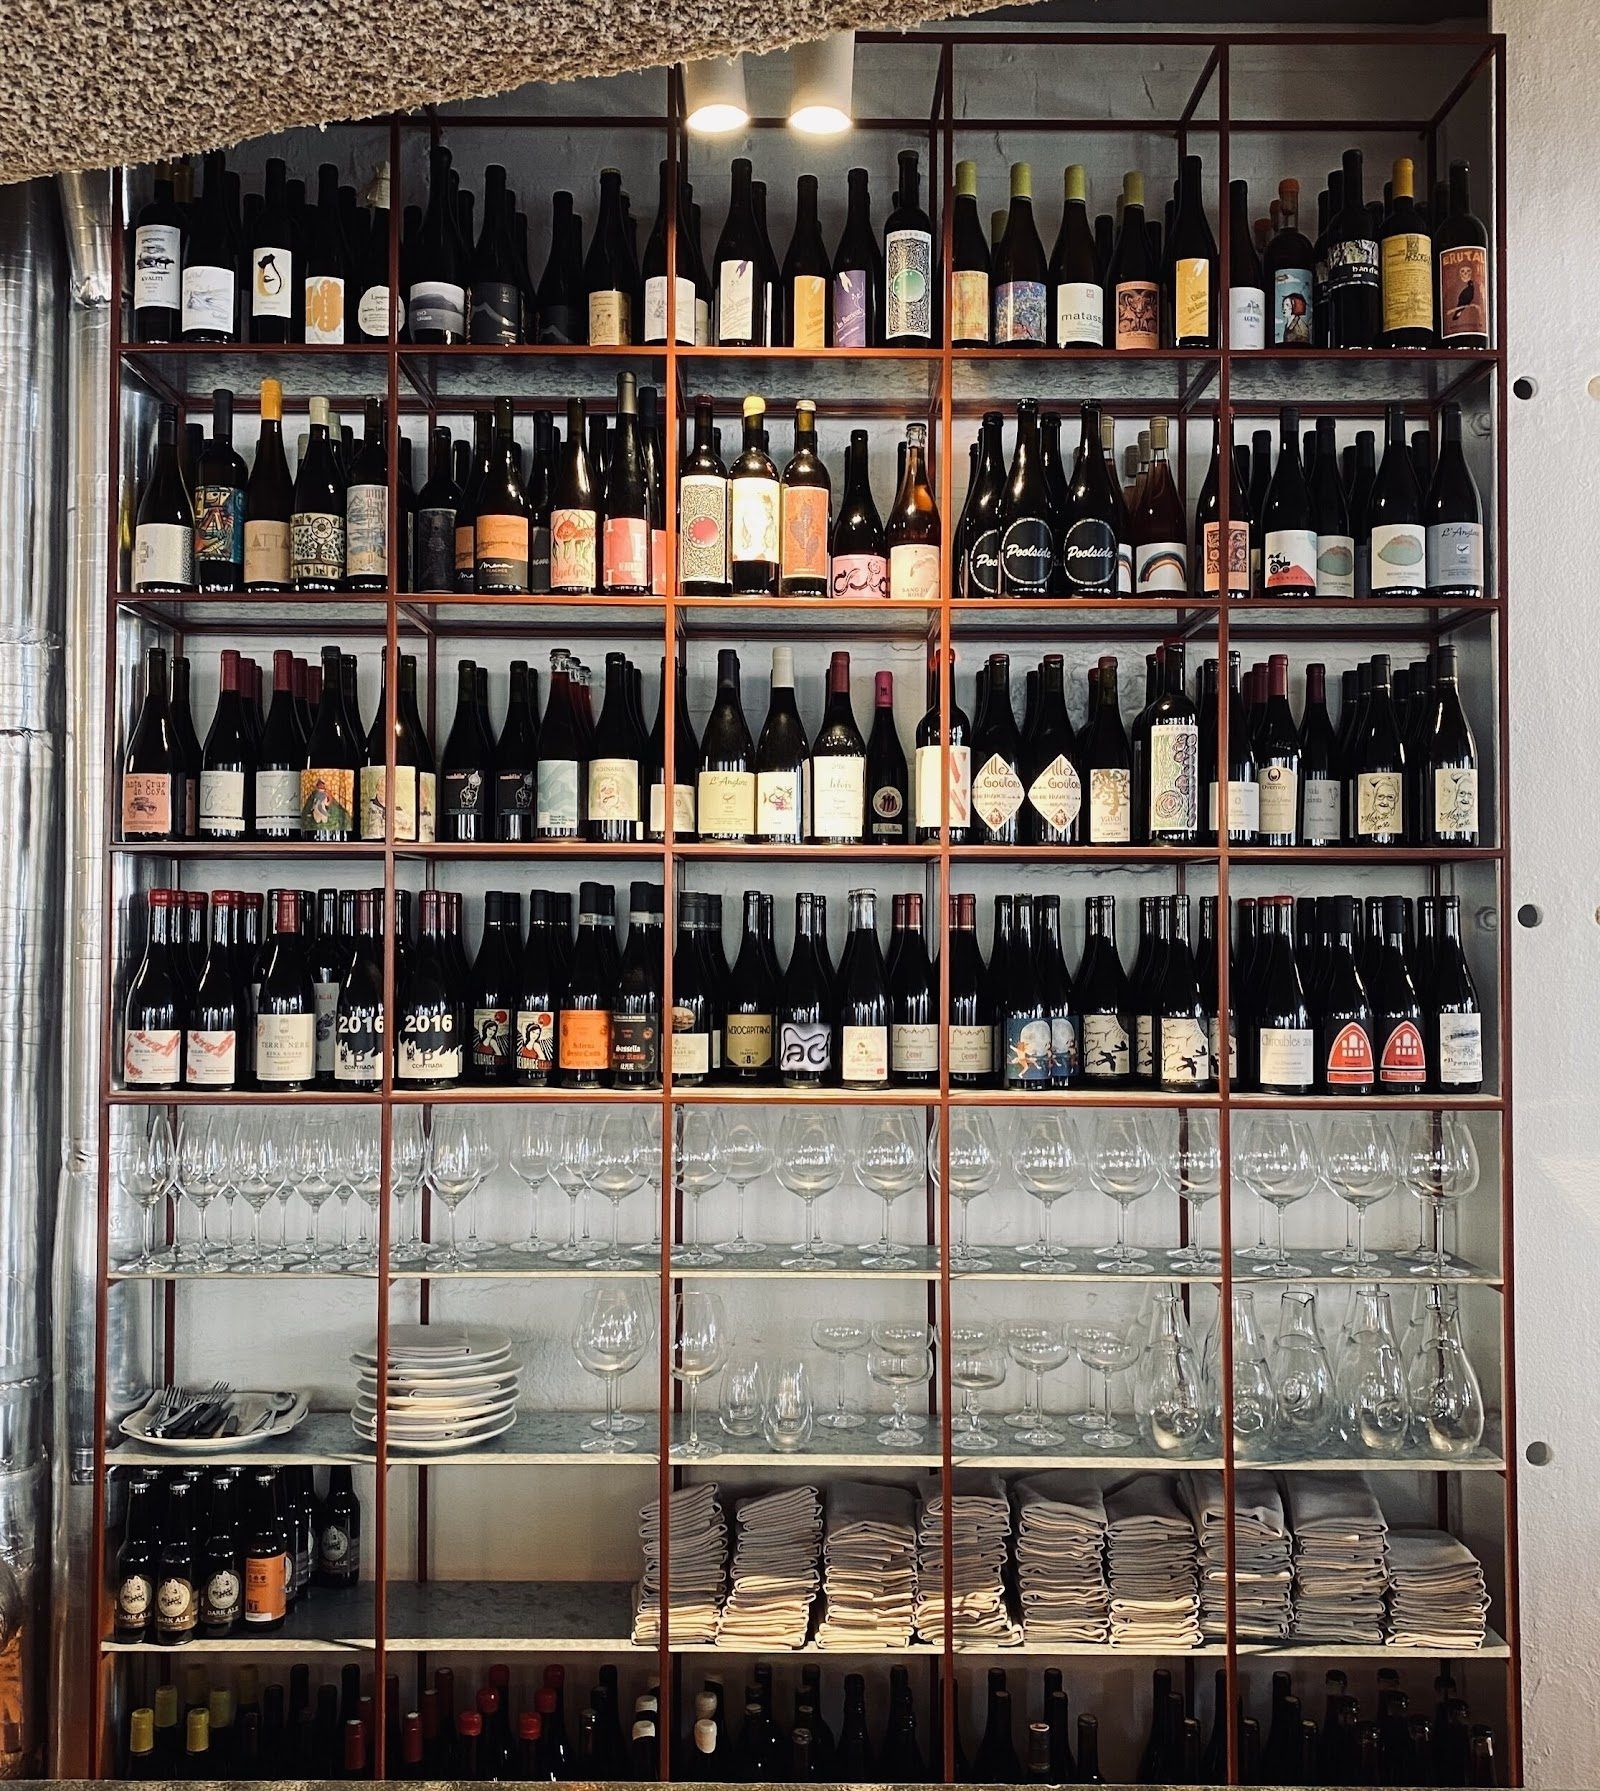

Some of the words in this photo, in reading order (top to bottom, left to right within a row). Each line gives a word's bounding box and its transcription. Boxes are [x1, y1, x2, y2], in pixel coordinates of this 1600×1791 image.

[1442, 249, 1485, 266] BRUTAL
[1006, 543, 1052, 560] Poolside
[1067, 545, 1114, 561] Poolside
[145, 780, 167, 789] Cruz
[338, 1015, 384, 1034] 2016
[404, 1014, 453, 1033] 2016
[727, 1025, 771, 1035] NEROCAPITANO
[261, 1041, 285, 1049] TERRE
[207, 1608, 225, 1617] DARK
[225, 1605, 240, 1615] ALE
[174, 1614, 190, 1623] ALE
